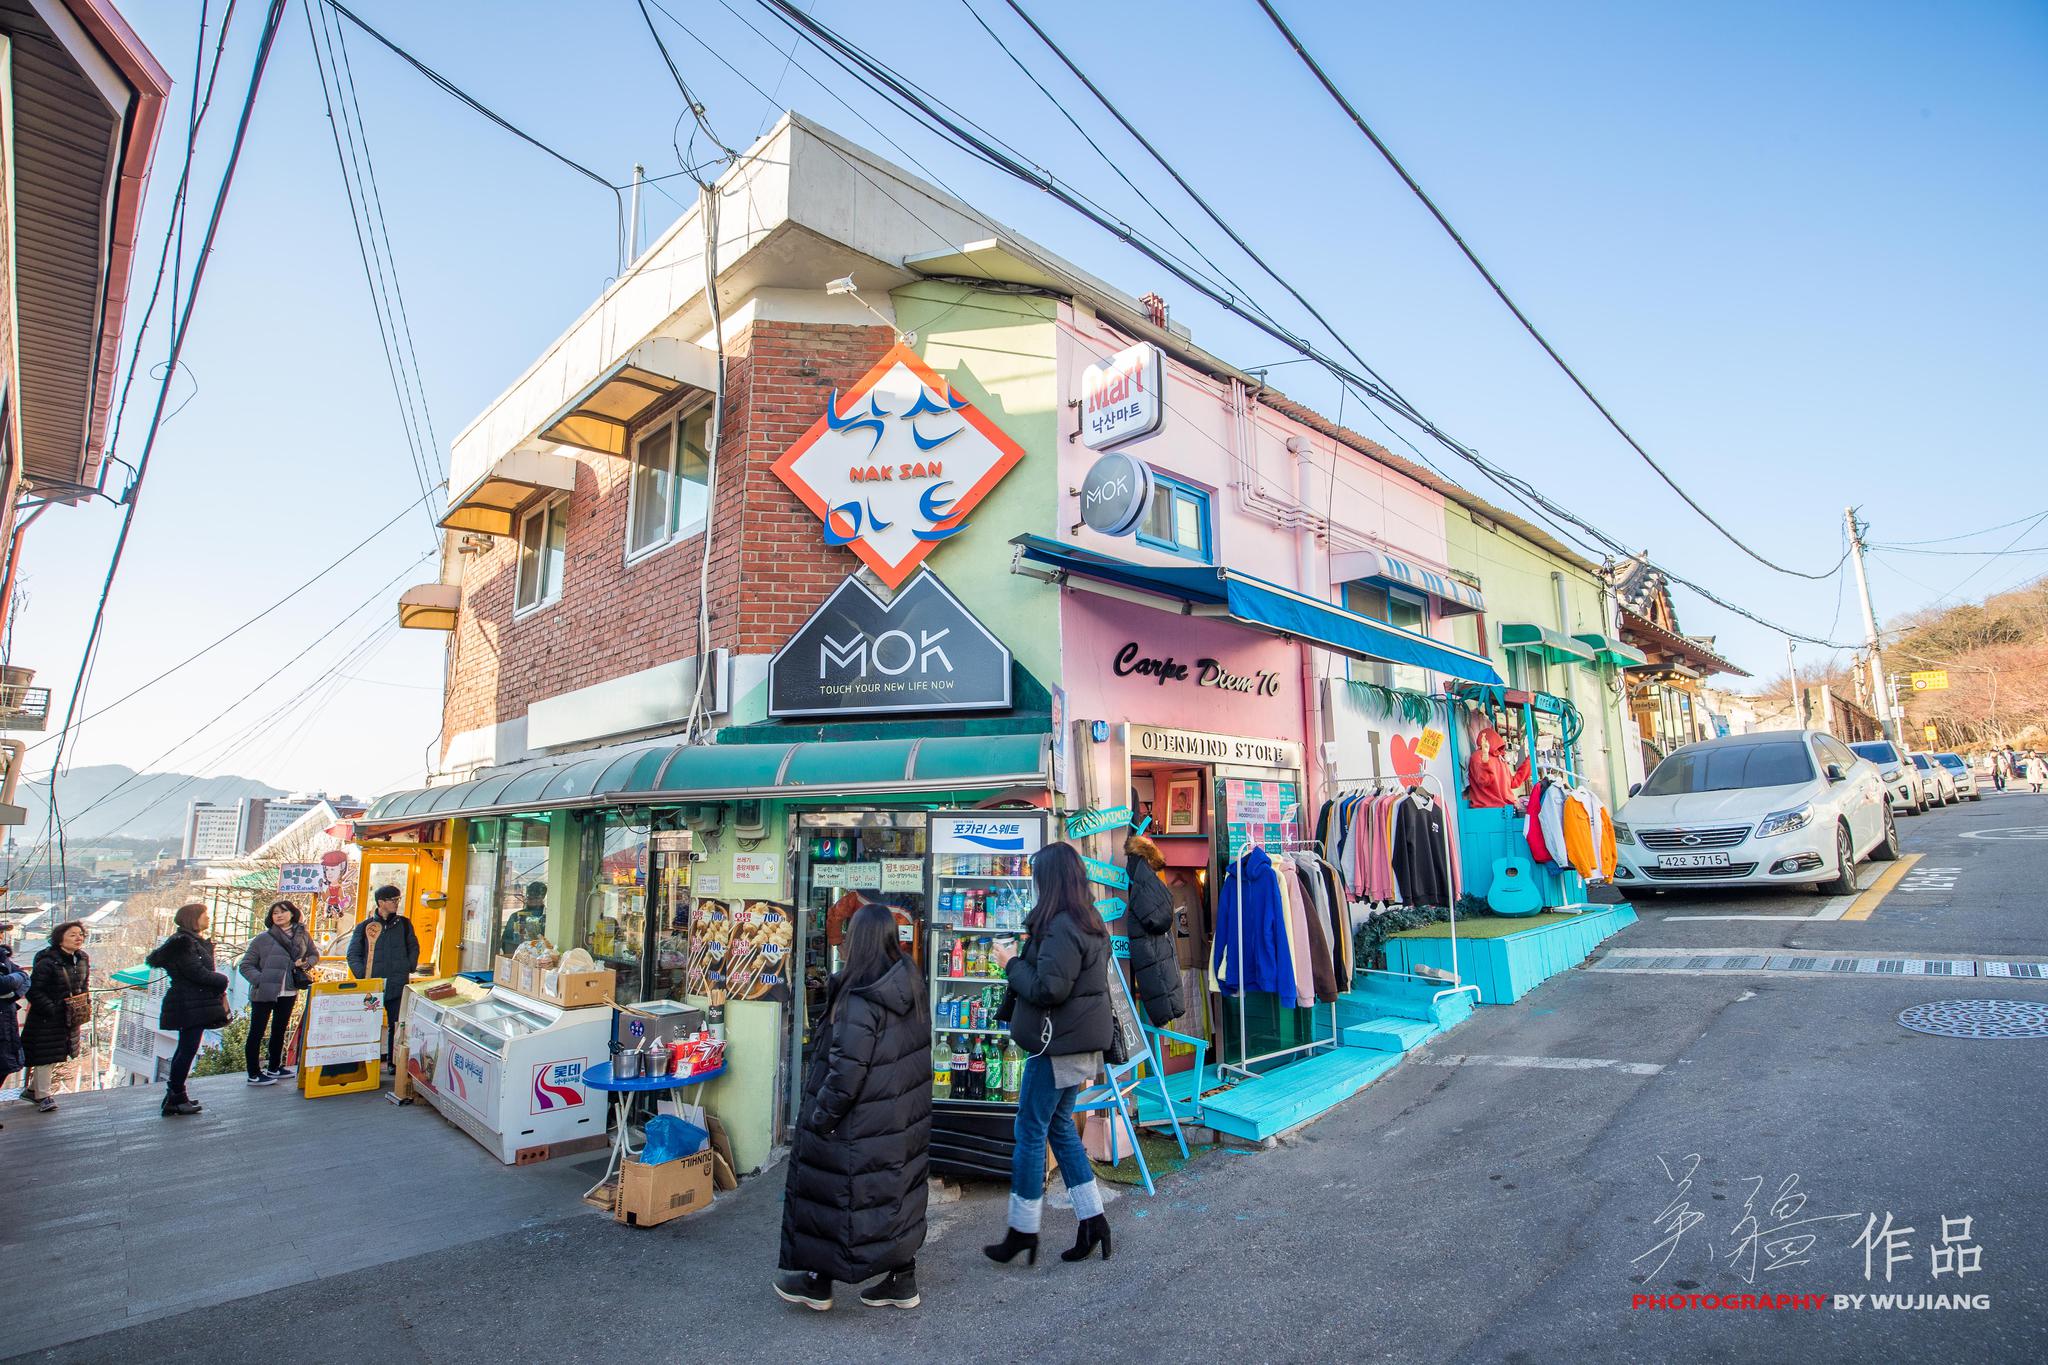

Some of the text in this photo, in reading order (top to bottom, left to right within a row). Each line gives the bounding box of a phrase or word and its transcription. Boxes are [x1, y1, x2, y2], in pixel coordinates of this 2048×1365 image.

[1088, 357, 1144, 414] Mart
[826, 384, 972, 458] 낙산
[1092, 402, 1142, 434] 낙산마트
[850, 461, 943, 483] NAK SAN
[1086, 475, 1129, 509] MOK
[823, 480, 973, 546] 마트
[820, 628, 954, 679] MOK
[1113, 642, 1189, 685] Carpe
[1196, 658, 1255, 693] Diem
[820, 680, 955, 695] TOUCH YOUR NEW LIFE NOW
[1142, 732, 1283, 762] OPENMIND STORE
[953, 824, 1020, 834] 포카리 스웨트
[1665, 855, 1723, 867] 42오 3715
[735, 912, 752, 922] 오뎅
[763, 913, 779, 923] 700
[761, 944, 778, 953] 700
[761, 974, 778, 984] 700
[454, 1052, 464, 1070] 롯데
[554, 1063, 581, 1078] 롯데
[681, 1152, 712, 1169] DUNHILL
